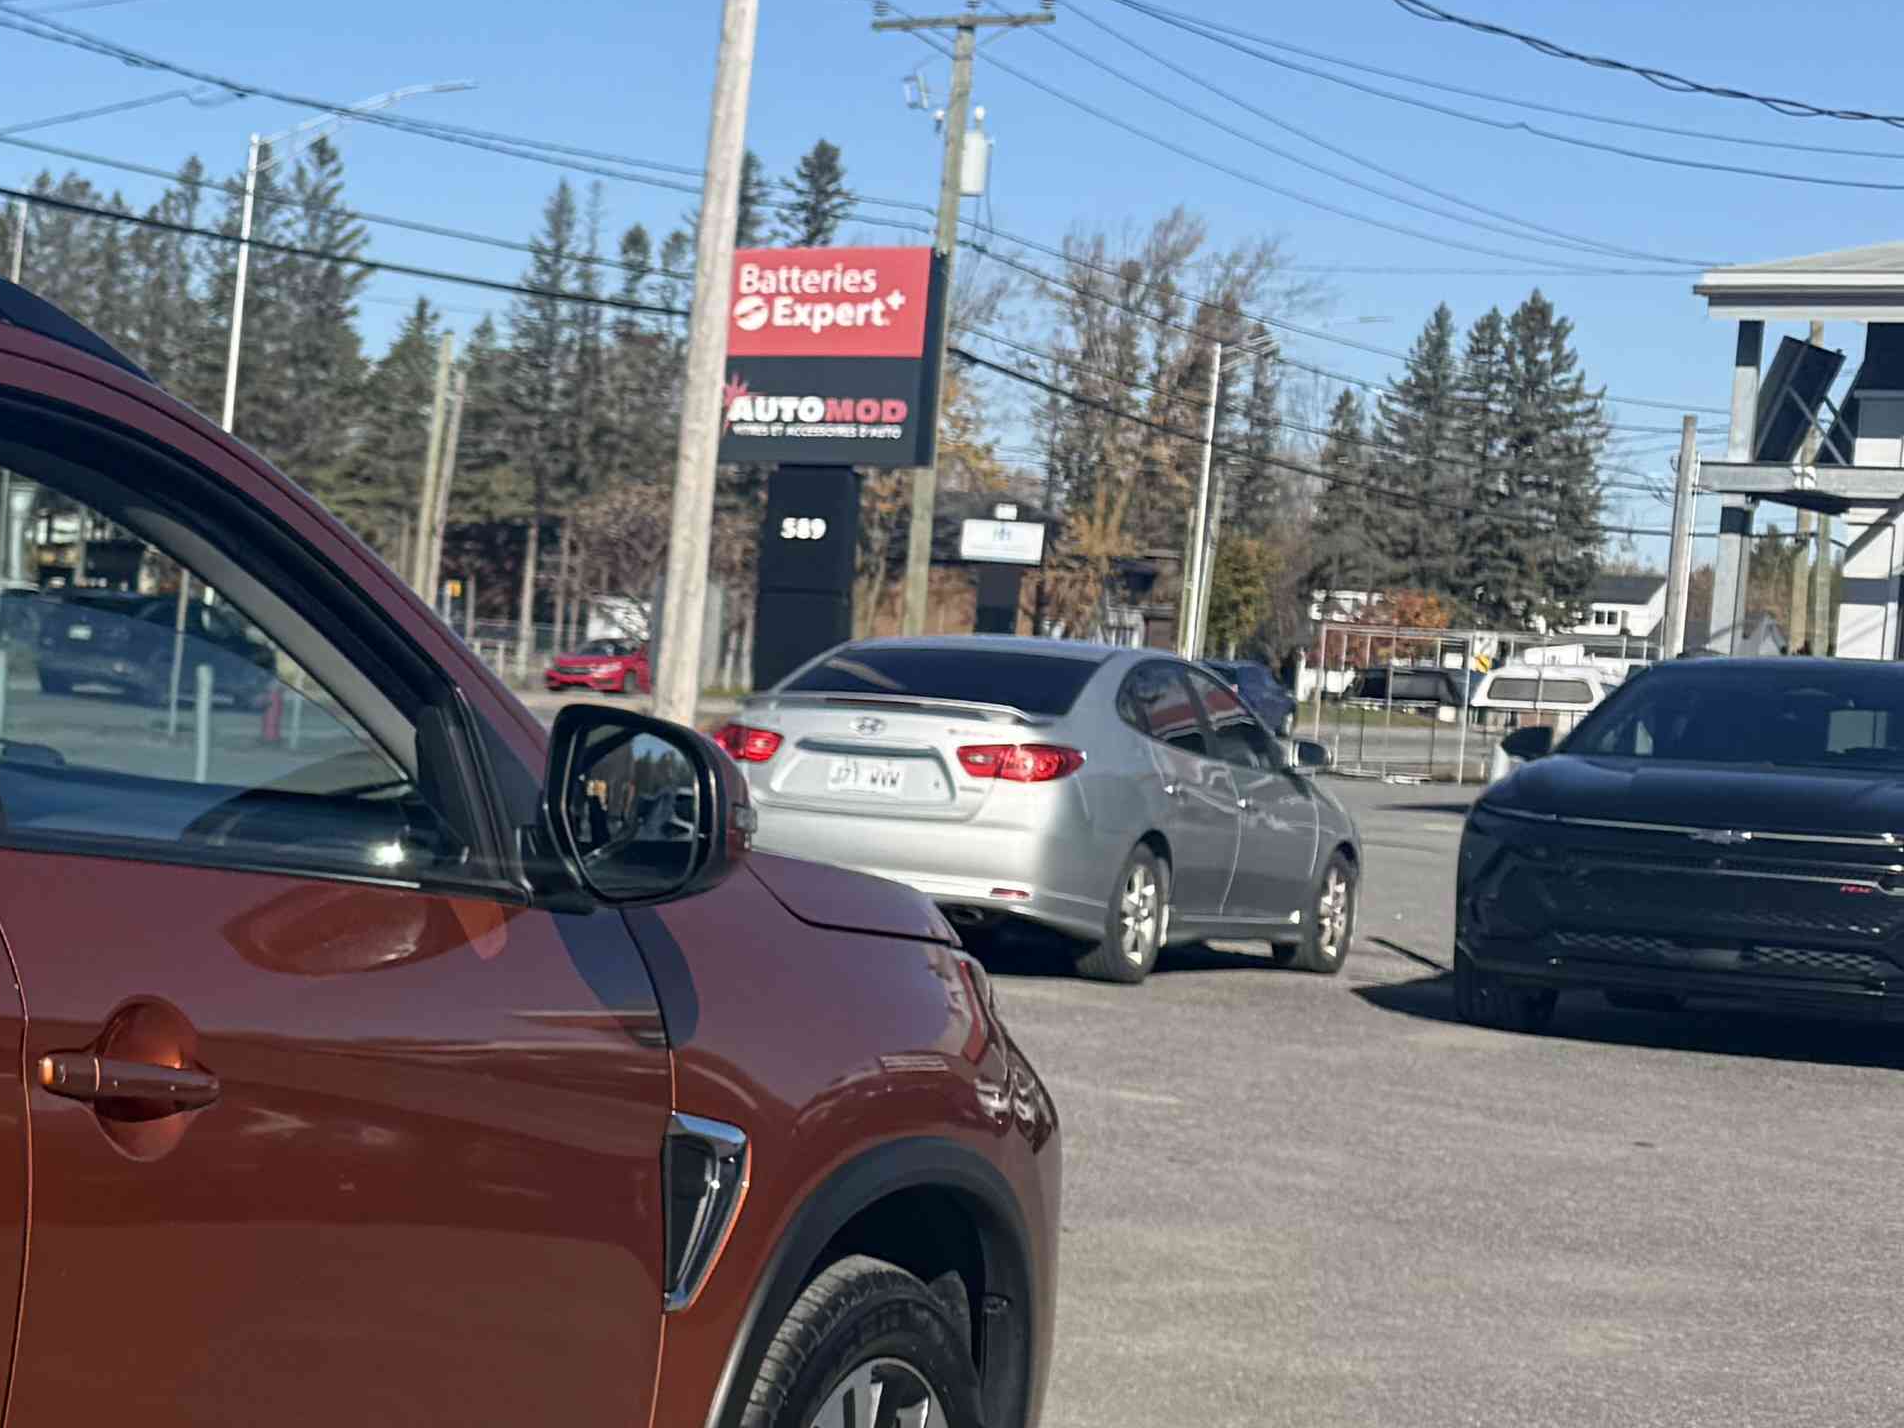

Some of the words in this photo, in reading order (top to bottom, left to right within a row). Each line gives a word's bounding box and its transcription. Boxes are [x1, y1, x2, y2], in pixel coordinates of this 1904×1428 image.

[738, 262, 878, 294] Batteries
[726, 395, 908, 424] AUTOMOD
[780, 517, 827, 540] 589
